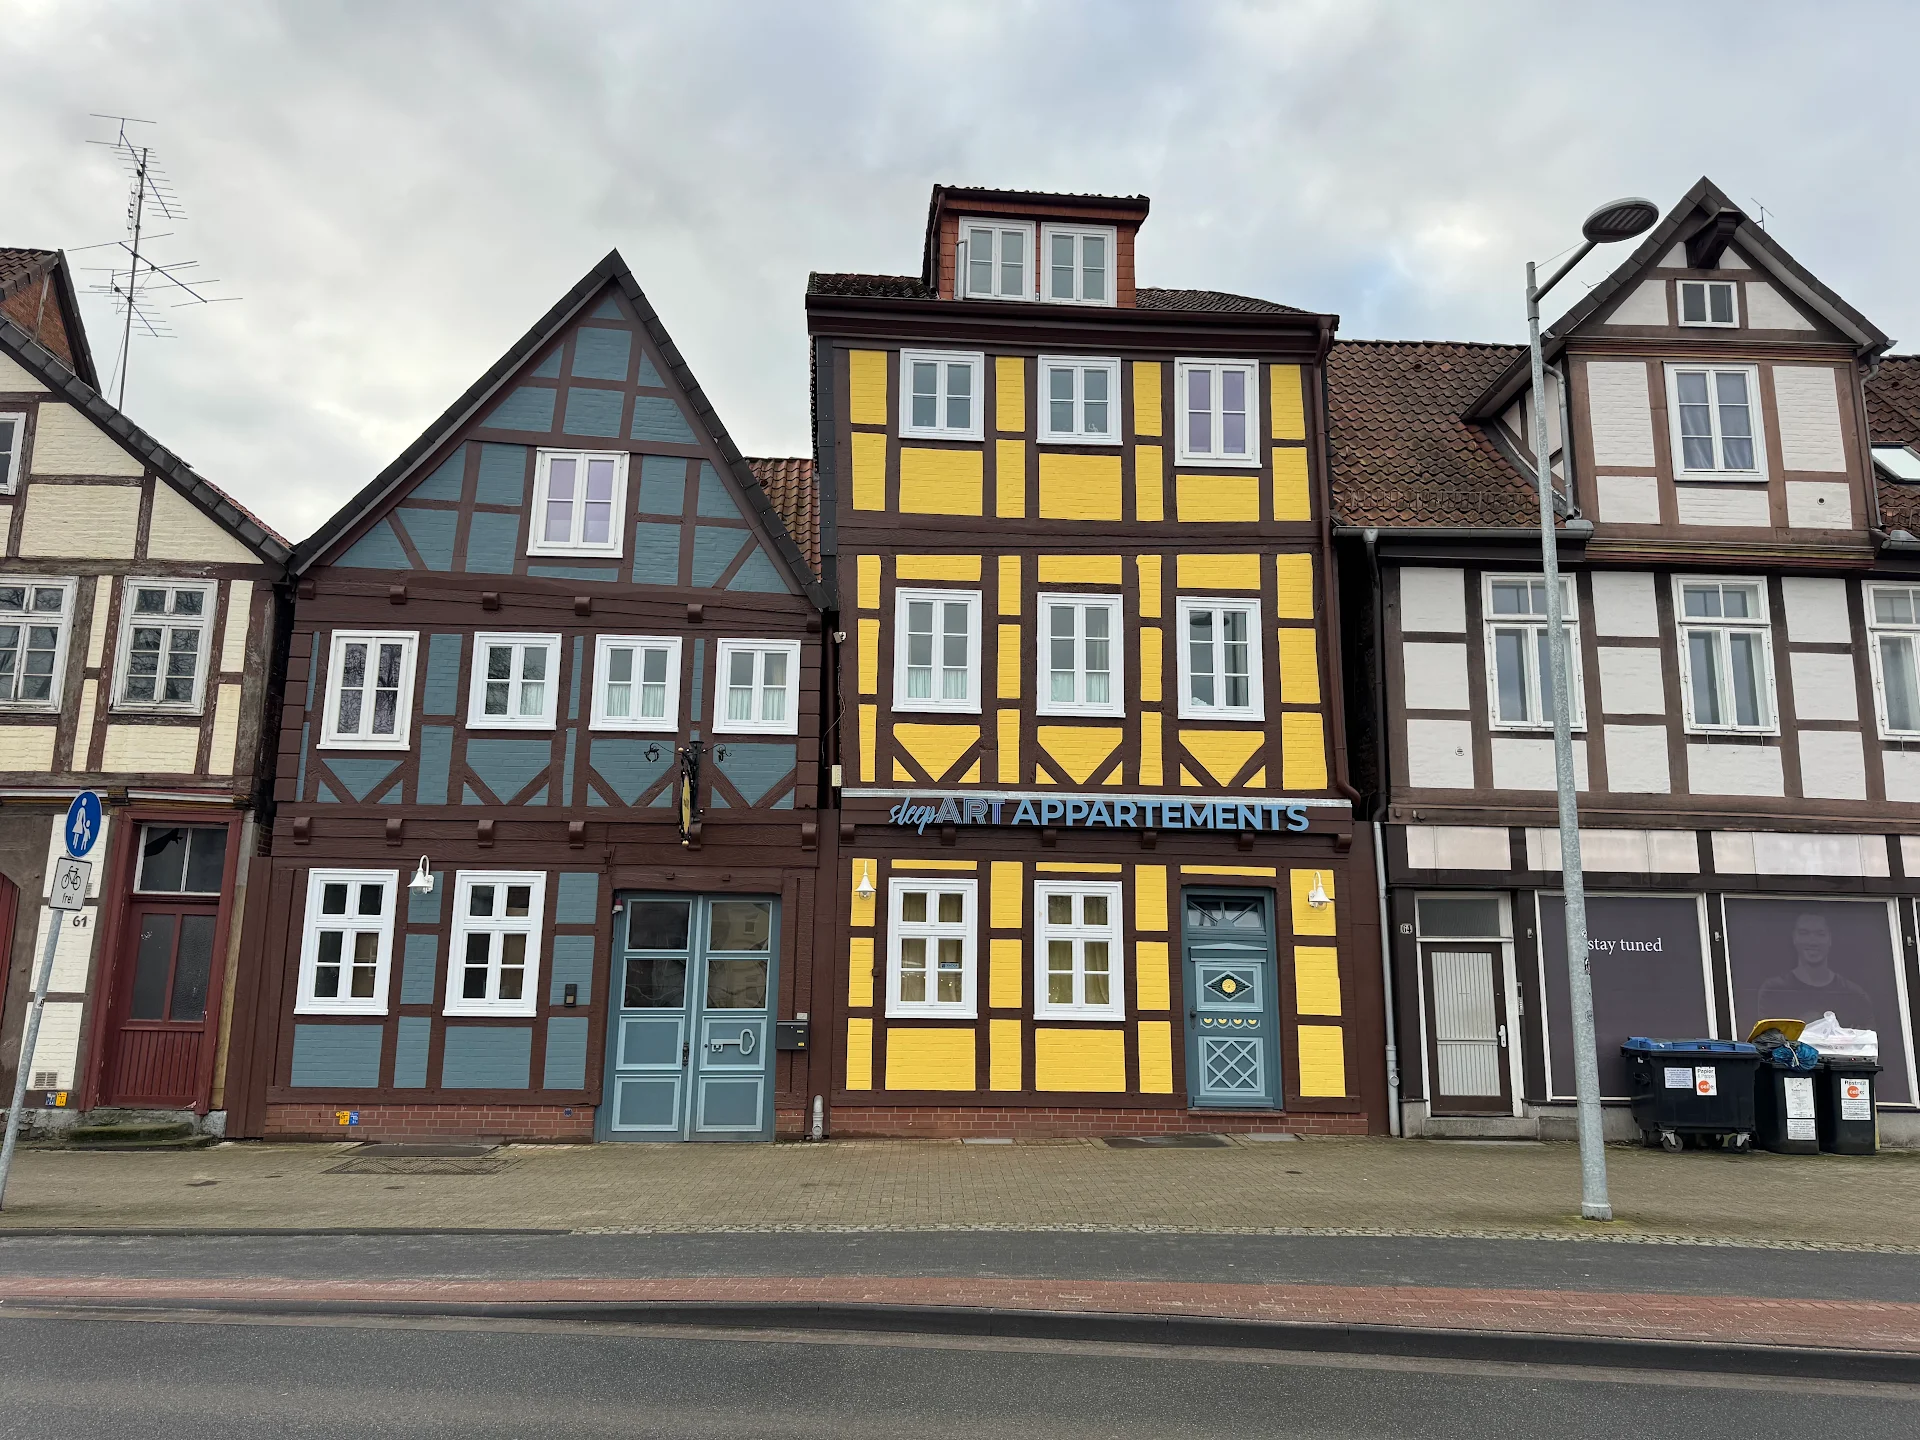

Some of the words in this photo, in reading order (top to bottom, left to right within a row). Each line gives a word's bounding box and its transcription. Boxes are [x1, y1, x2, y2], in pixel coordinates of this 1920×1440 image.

[1011, 799, 1310, 832] APPARTEMENTS
[61, 892, 75, 904] frei
[72, 915, 87, 927] 61
[1587, 938, 1616, 955] stay
[1620, 937, 1663, 952] tuned
